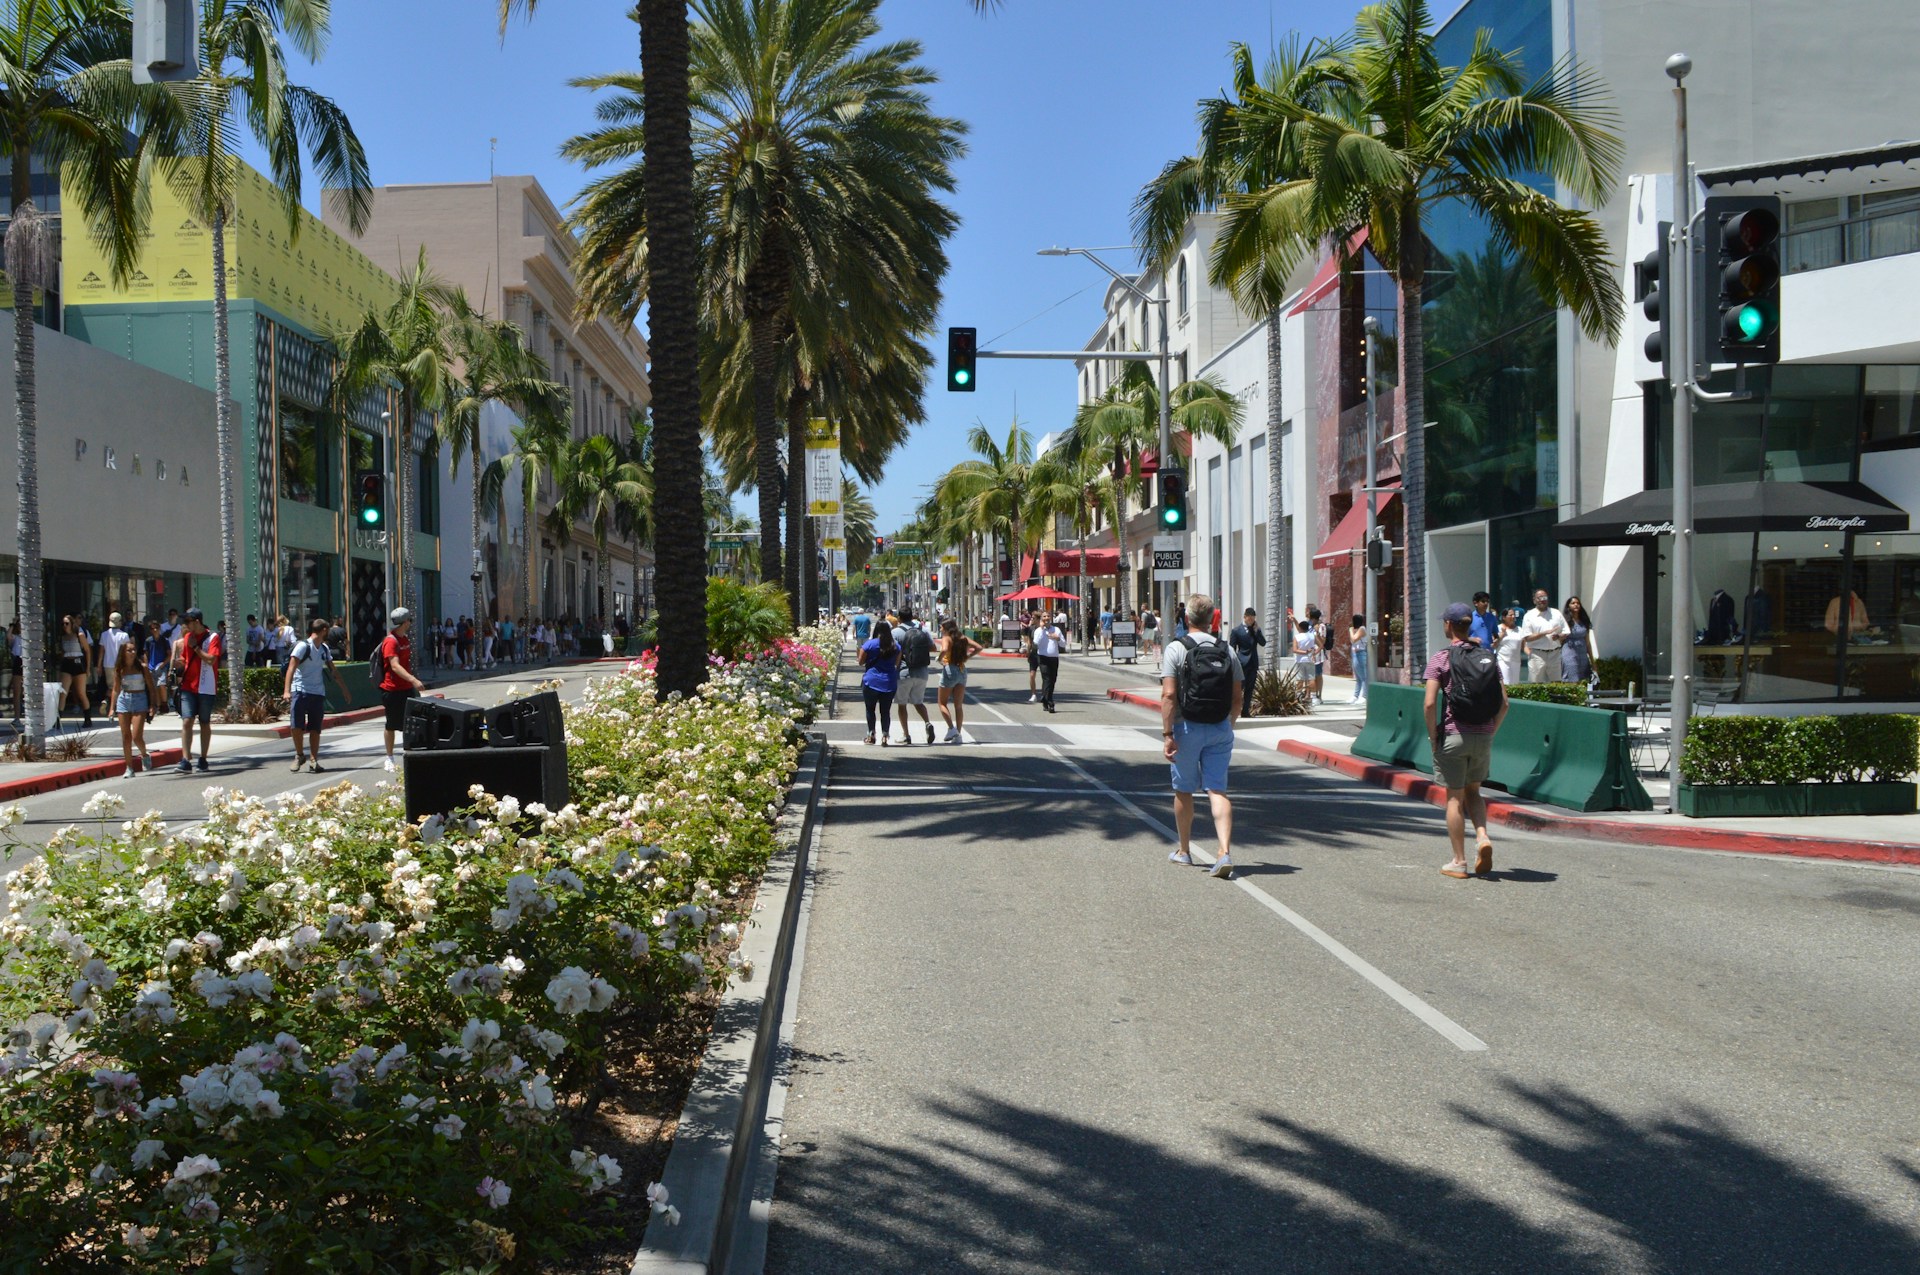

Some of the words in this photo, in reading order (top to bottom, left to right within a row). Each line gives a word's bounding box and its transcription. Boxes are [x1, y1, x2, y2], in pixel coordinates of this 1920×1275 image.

[75, 438, 190, 487] PRADA
[1625, 521, 1675, 536] Battaglia
[1805, 516, 1867, 530] Battaglia
[1155, 552, 1182, 560] PUBLIC
[1157, 560, 1180, 568] VALET
